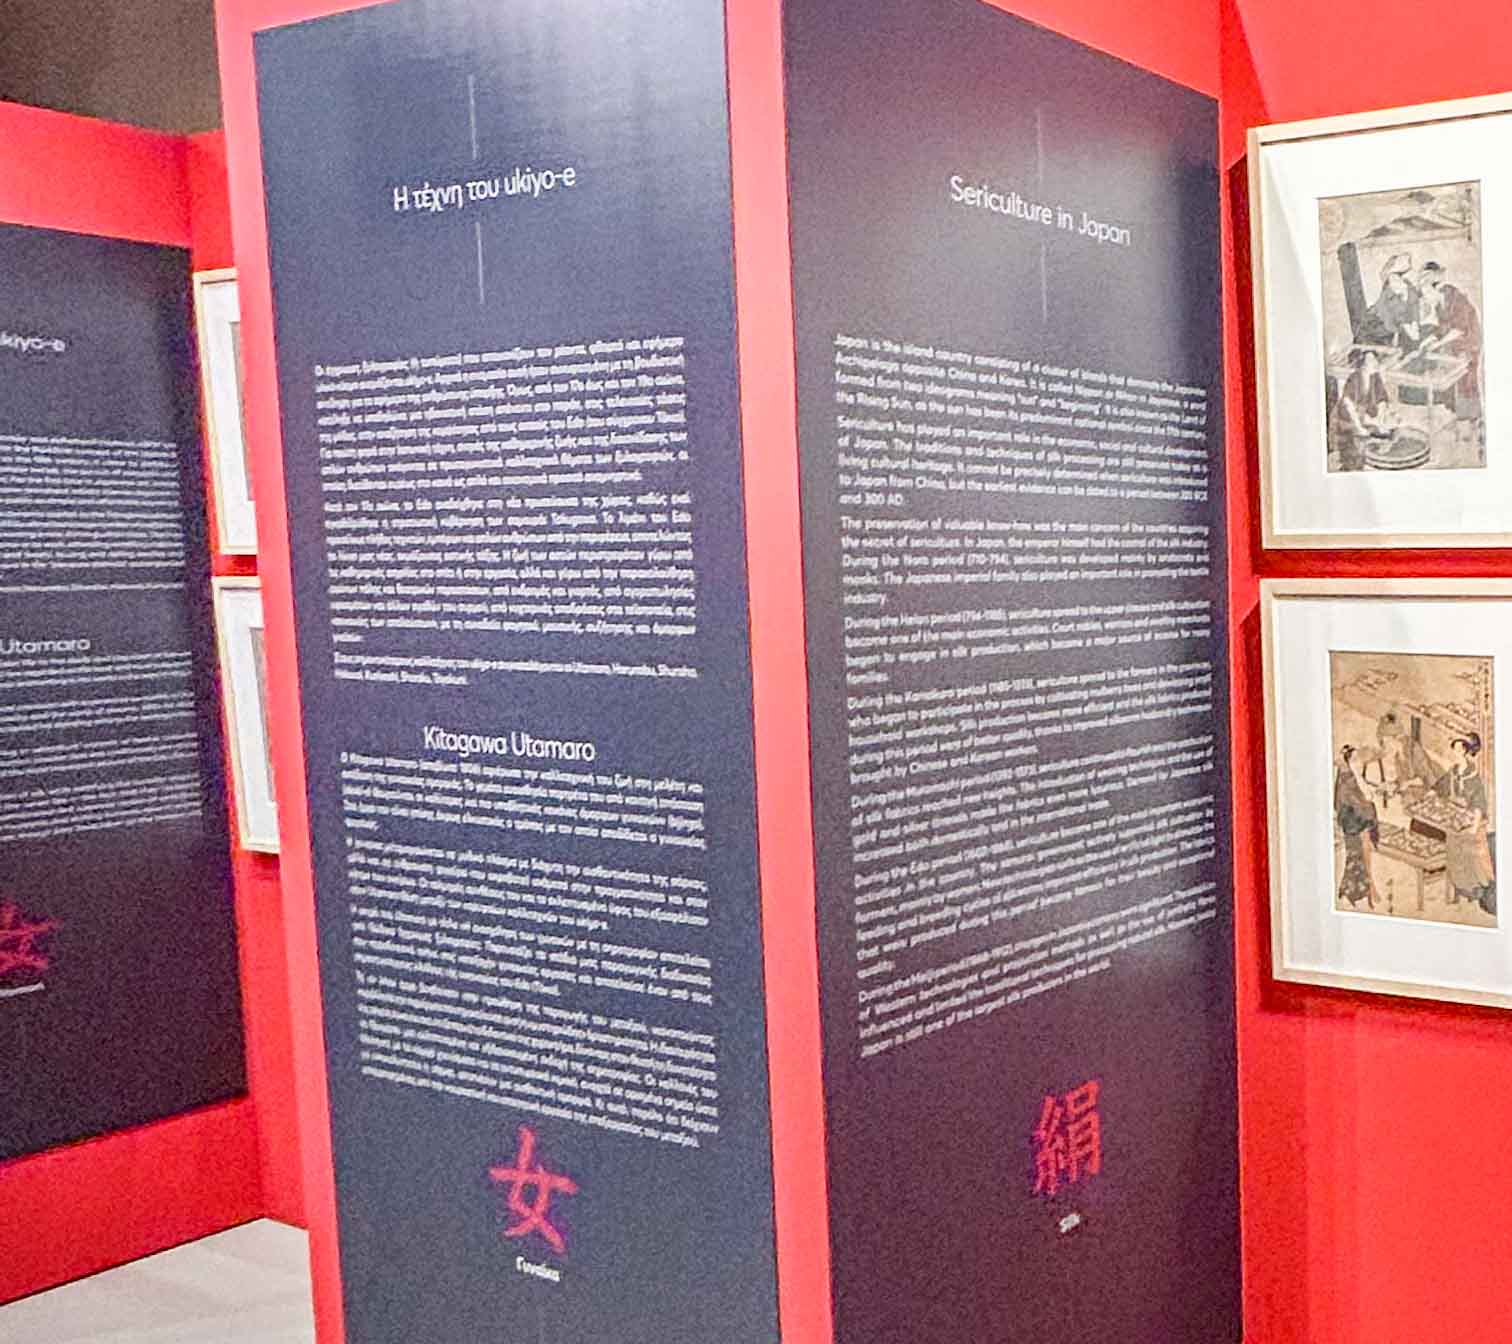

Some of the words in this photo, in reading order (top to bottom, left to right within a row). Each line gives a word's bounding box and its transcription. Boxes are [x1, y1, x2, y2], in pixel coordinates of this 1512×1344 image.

[412, 182, 463, 212] τέχνη
[466, 180, 499, 201] του
[504, 167, 576, 197] ukiyo-e
[950, 175, 1052, 224] Sericulture
[1057, 207, 1073, 231] in
[1078, 212, 1131, 246] Japan
[0, 330, 66, 353] kiyo-e
[0, 639, 91, 654] Utamaro
[424, 726, 507, 757] Kitagawa
[511, 731, 595, 761] Utamaro
[489, 1126, 579, 1253] 女
